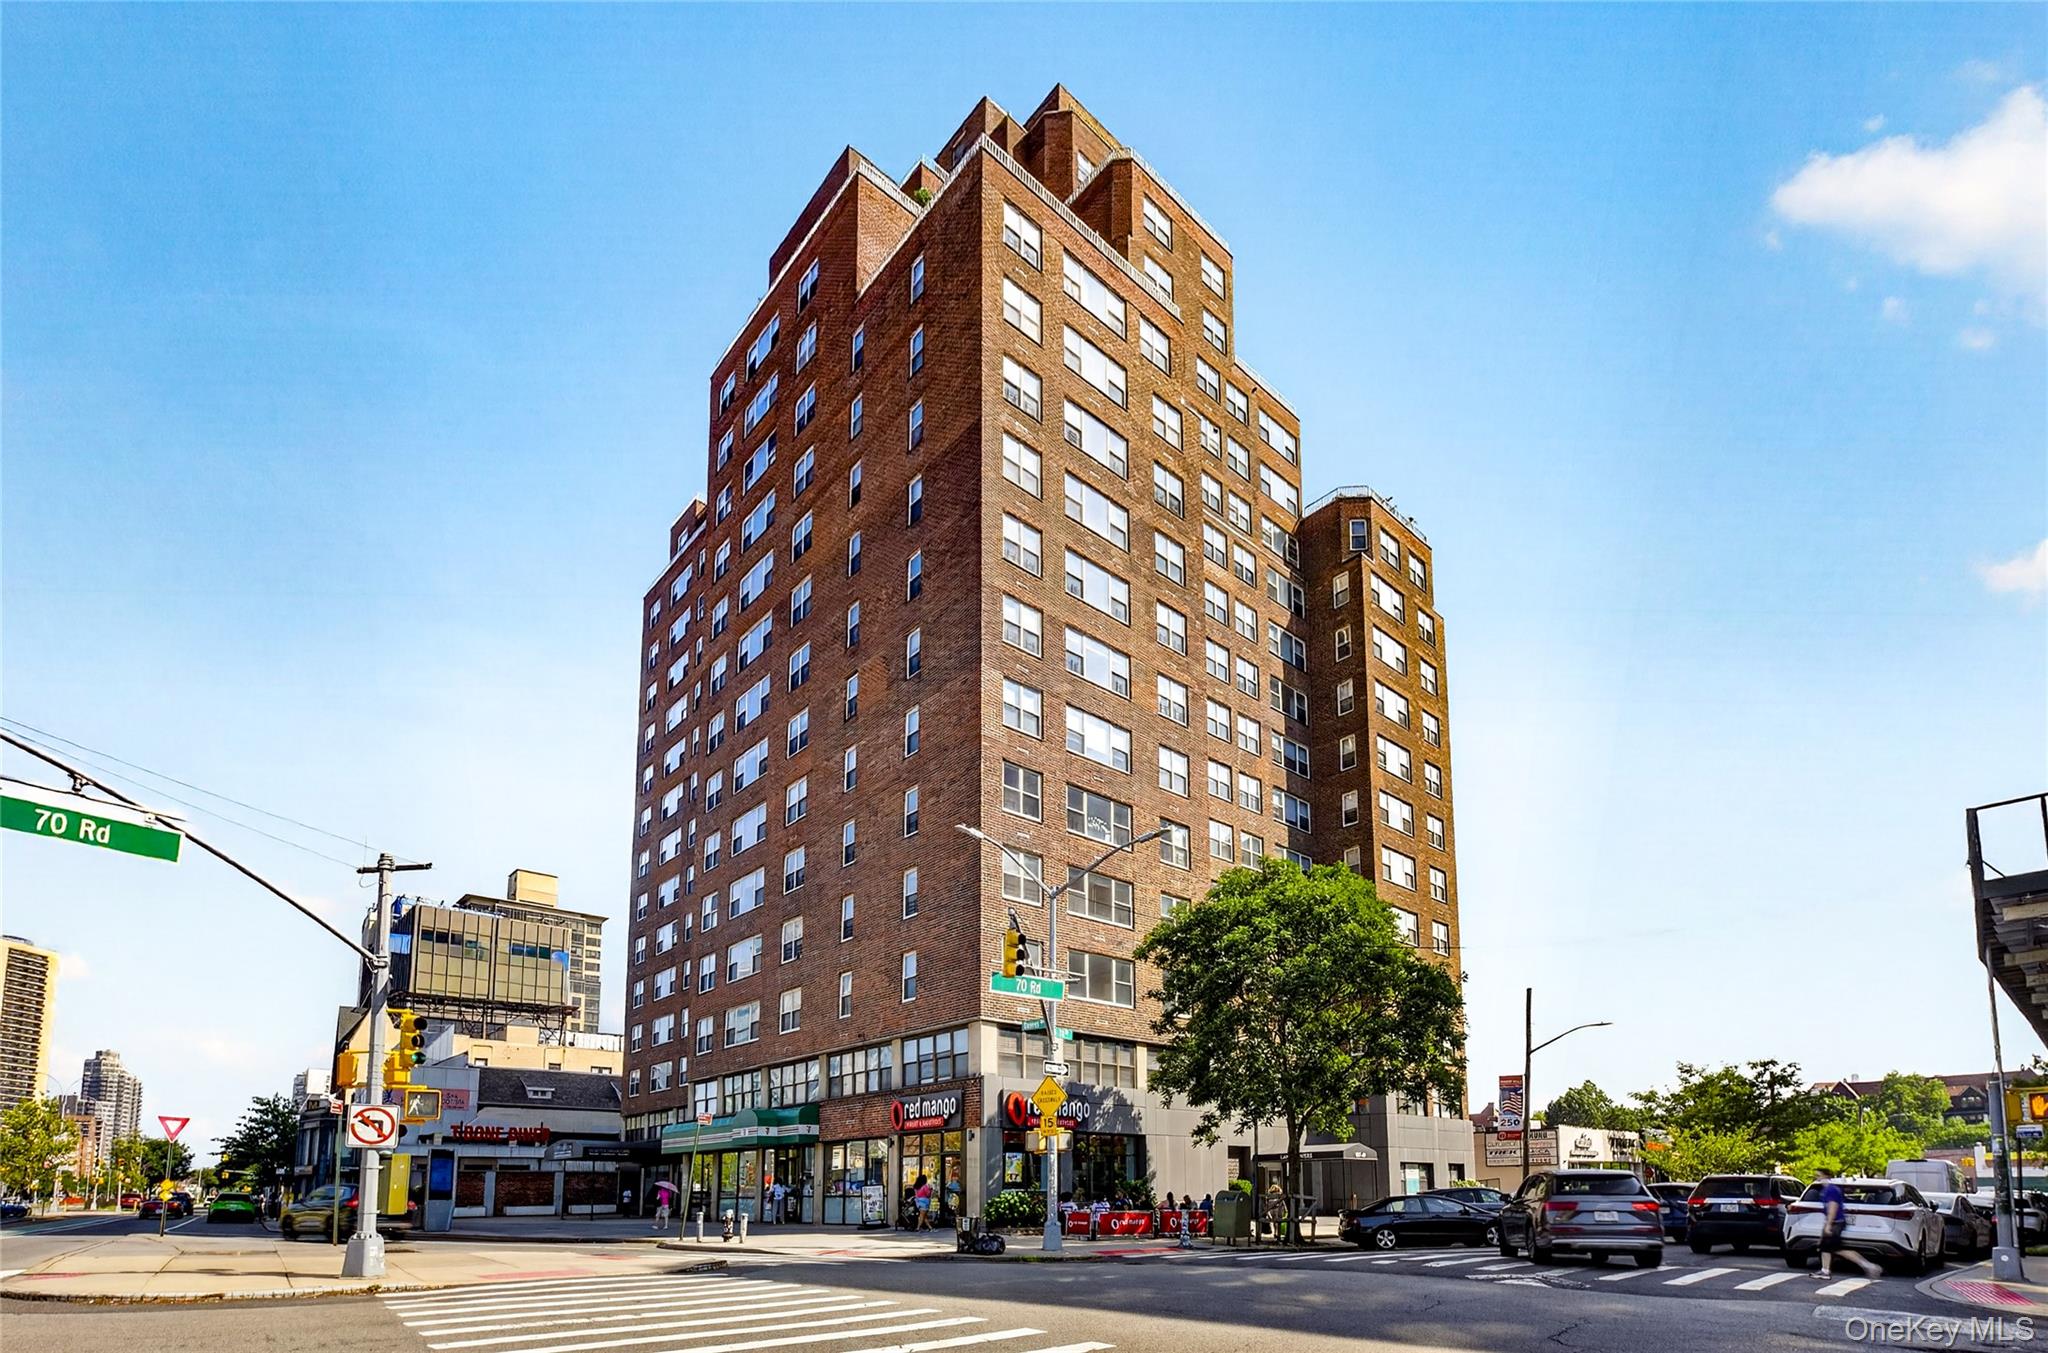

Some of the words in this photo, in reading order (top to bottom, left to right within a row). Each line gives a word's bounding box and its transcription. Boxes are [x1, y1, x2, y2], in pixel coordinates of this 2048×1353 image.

[35, 808, 68, 834] 70
[79, 818, 111, 844] Rd
[1016, 978, 1027, 992] 70
[1030, 981, 1041, 994] Rd
[904, 1097, 920, 1119] red
[922, 1097, 956, 1119] mango
[1043, 1117, 1054, 1128] 15
[1500, 1118, 1520, 1127] 250
